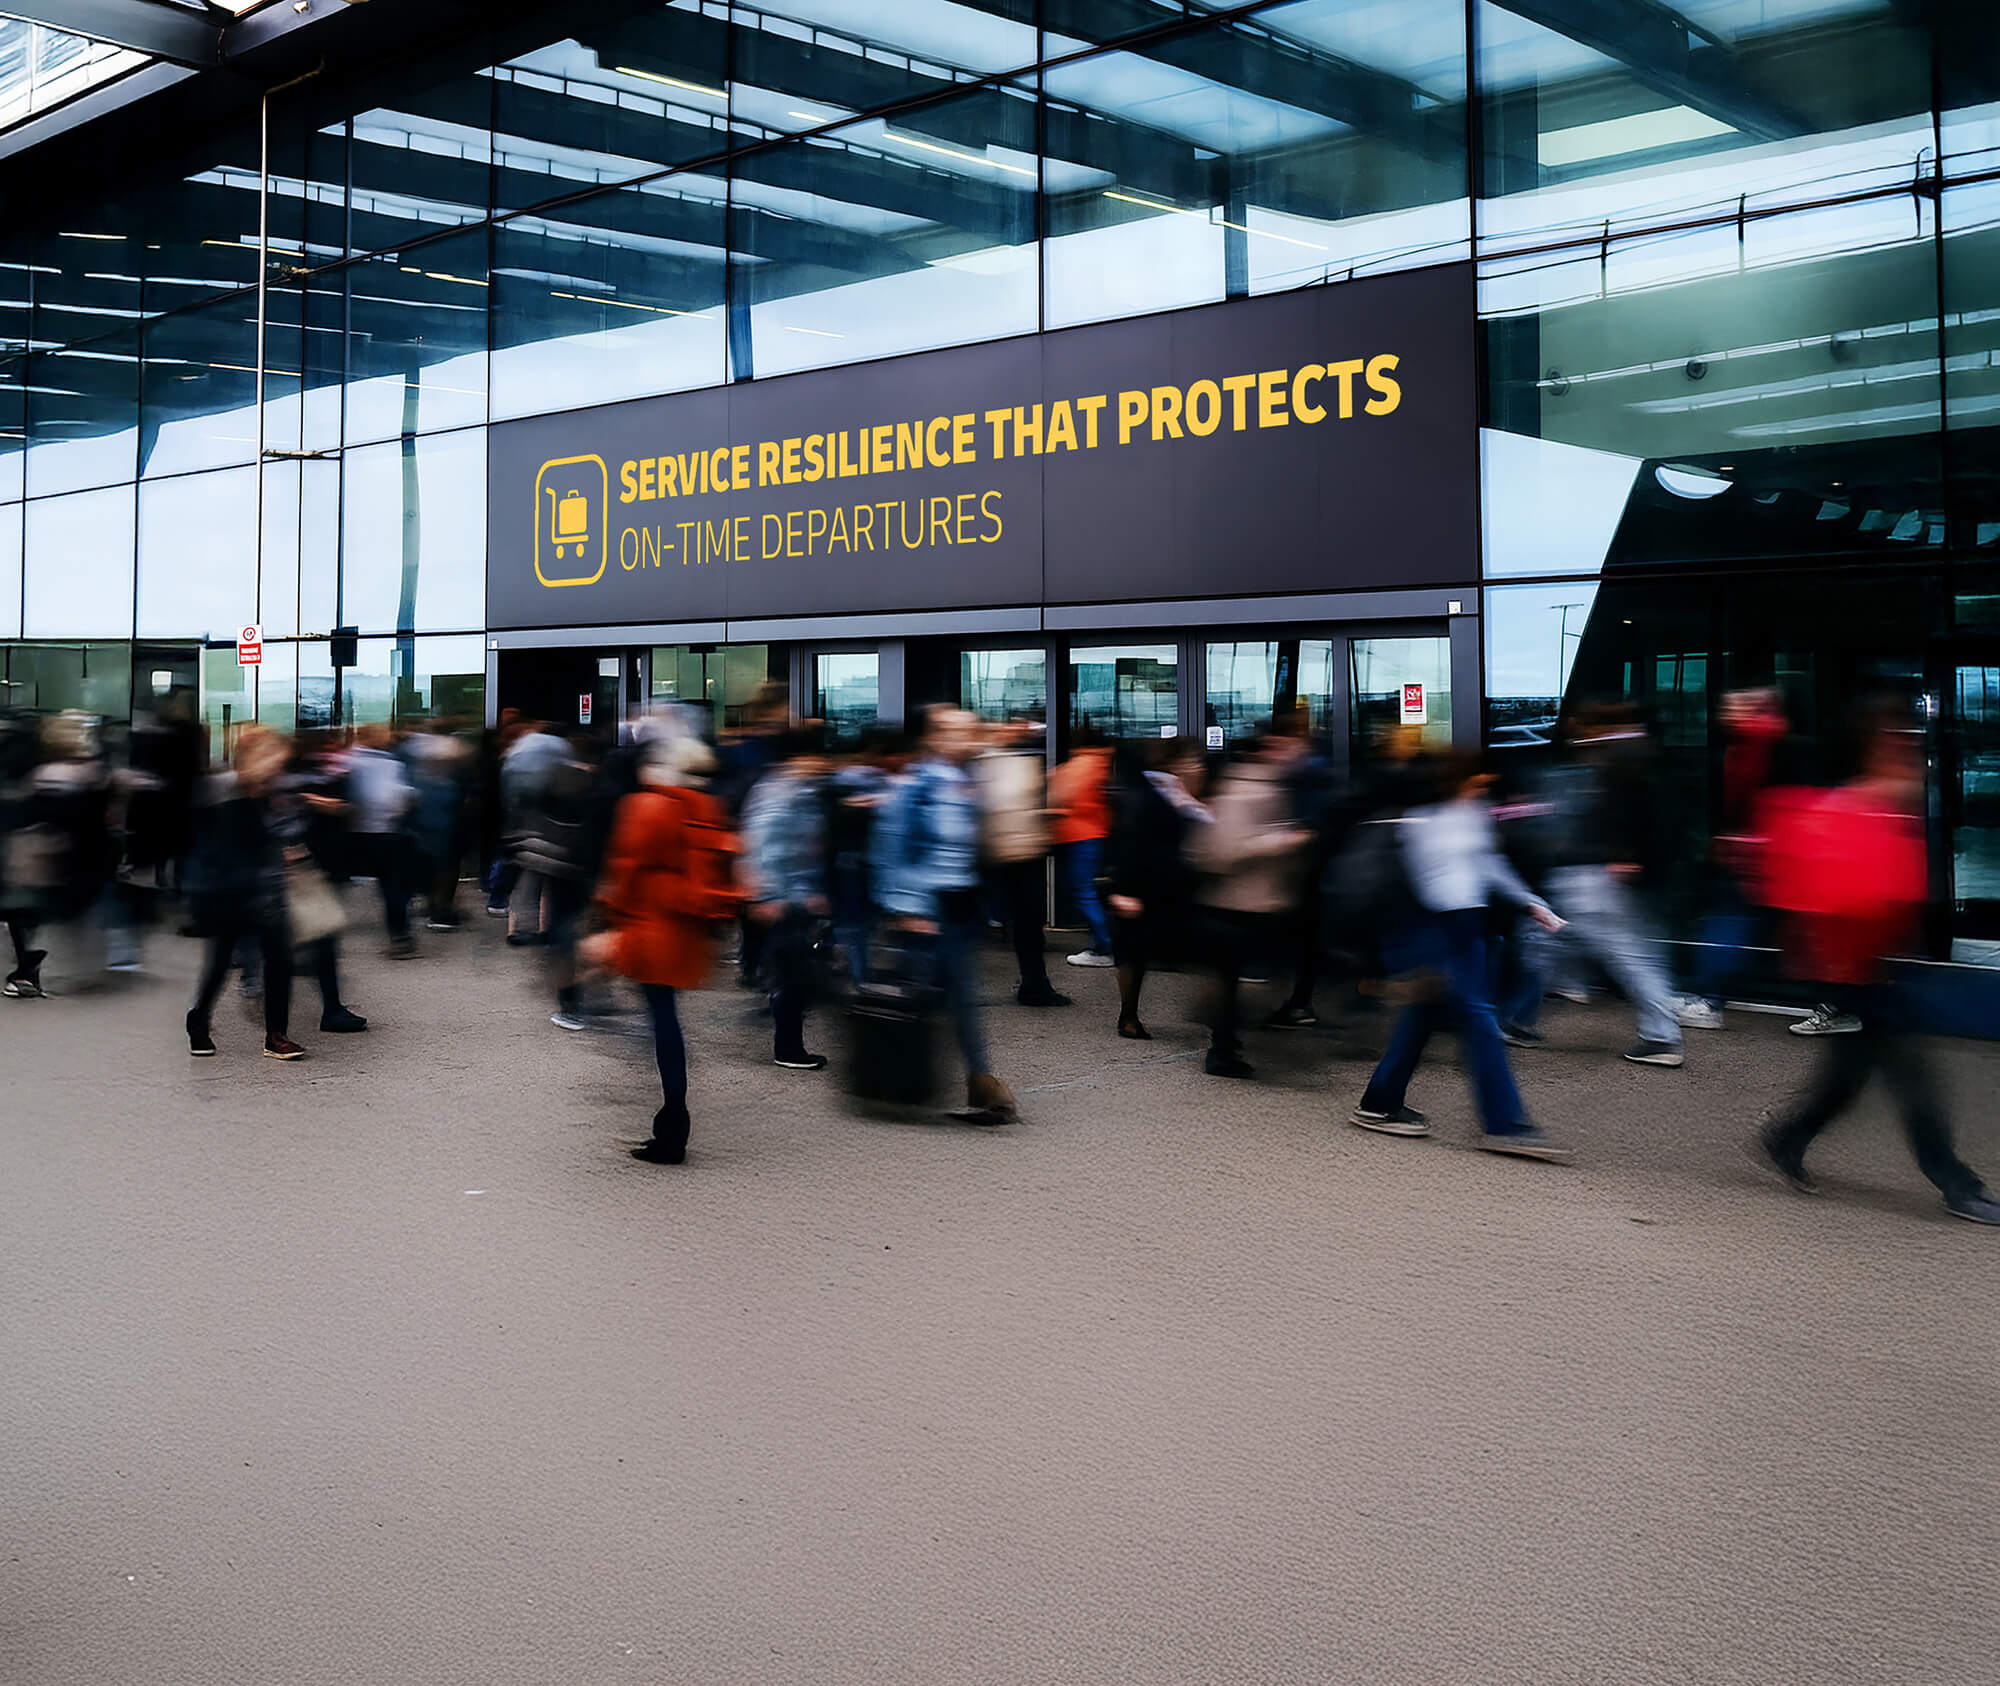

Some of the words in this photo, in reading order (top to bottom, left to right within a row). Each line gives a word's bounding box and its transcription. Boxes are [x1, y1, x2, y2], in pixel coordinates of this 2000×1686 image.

[619, 445, 751, 504] SERVICE
[758, 413, 977, 487] RESILIENCE
[984, 395, 1107, 460] THAT
[1118, 354, 1402, 445] PROTECTS
[619, 517, 751, 571] ON-TIME
[761, 490, 1003, 559] DEPARTURES
